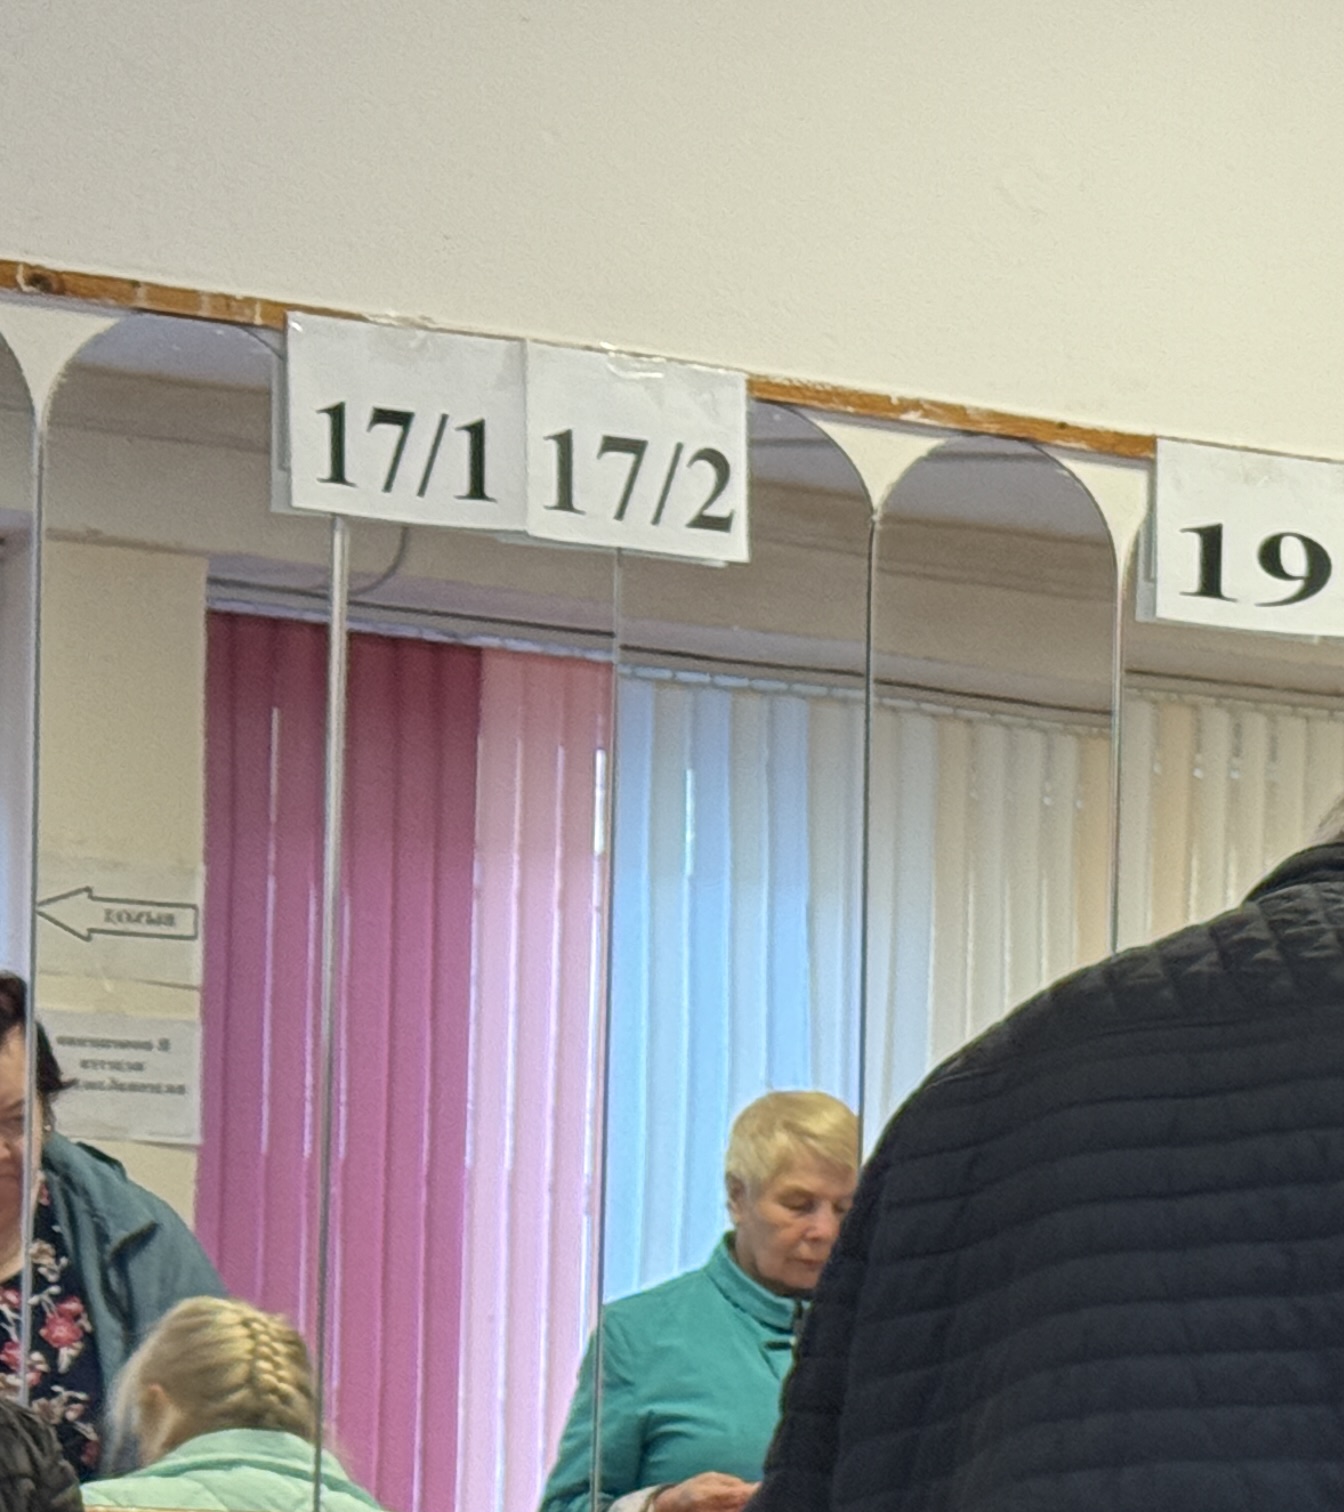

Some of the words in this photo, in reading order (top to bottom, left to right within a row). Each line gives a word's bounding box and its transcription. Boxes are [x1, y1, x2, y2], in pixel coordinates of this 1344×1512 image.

[317, 400, 498, 503] 17/1
[543, 428, 736, 534] 17/2
[1180, 523, 1334, 608] 19
